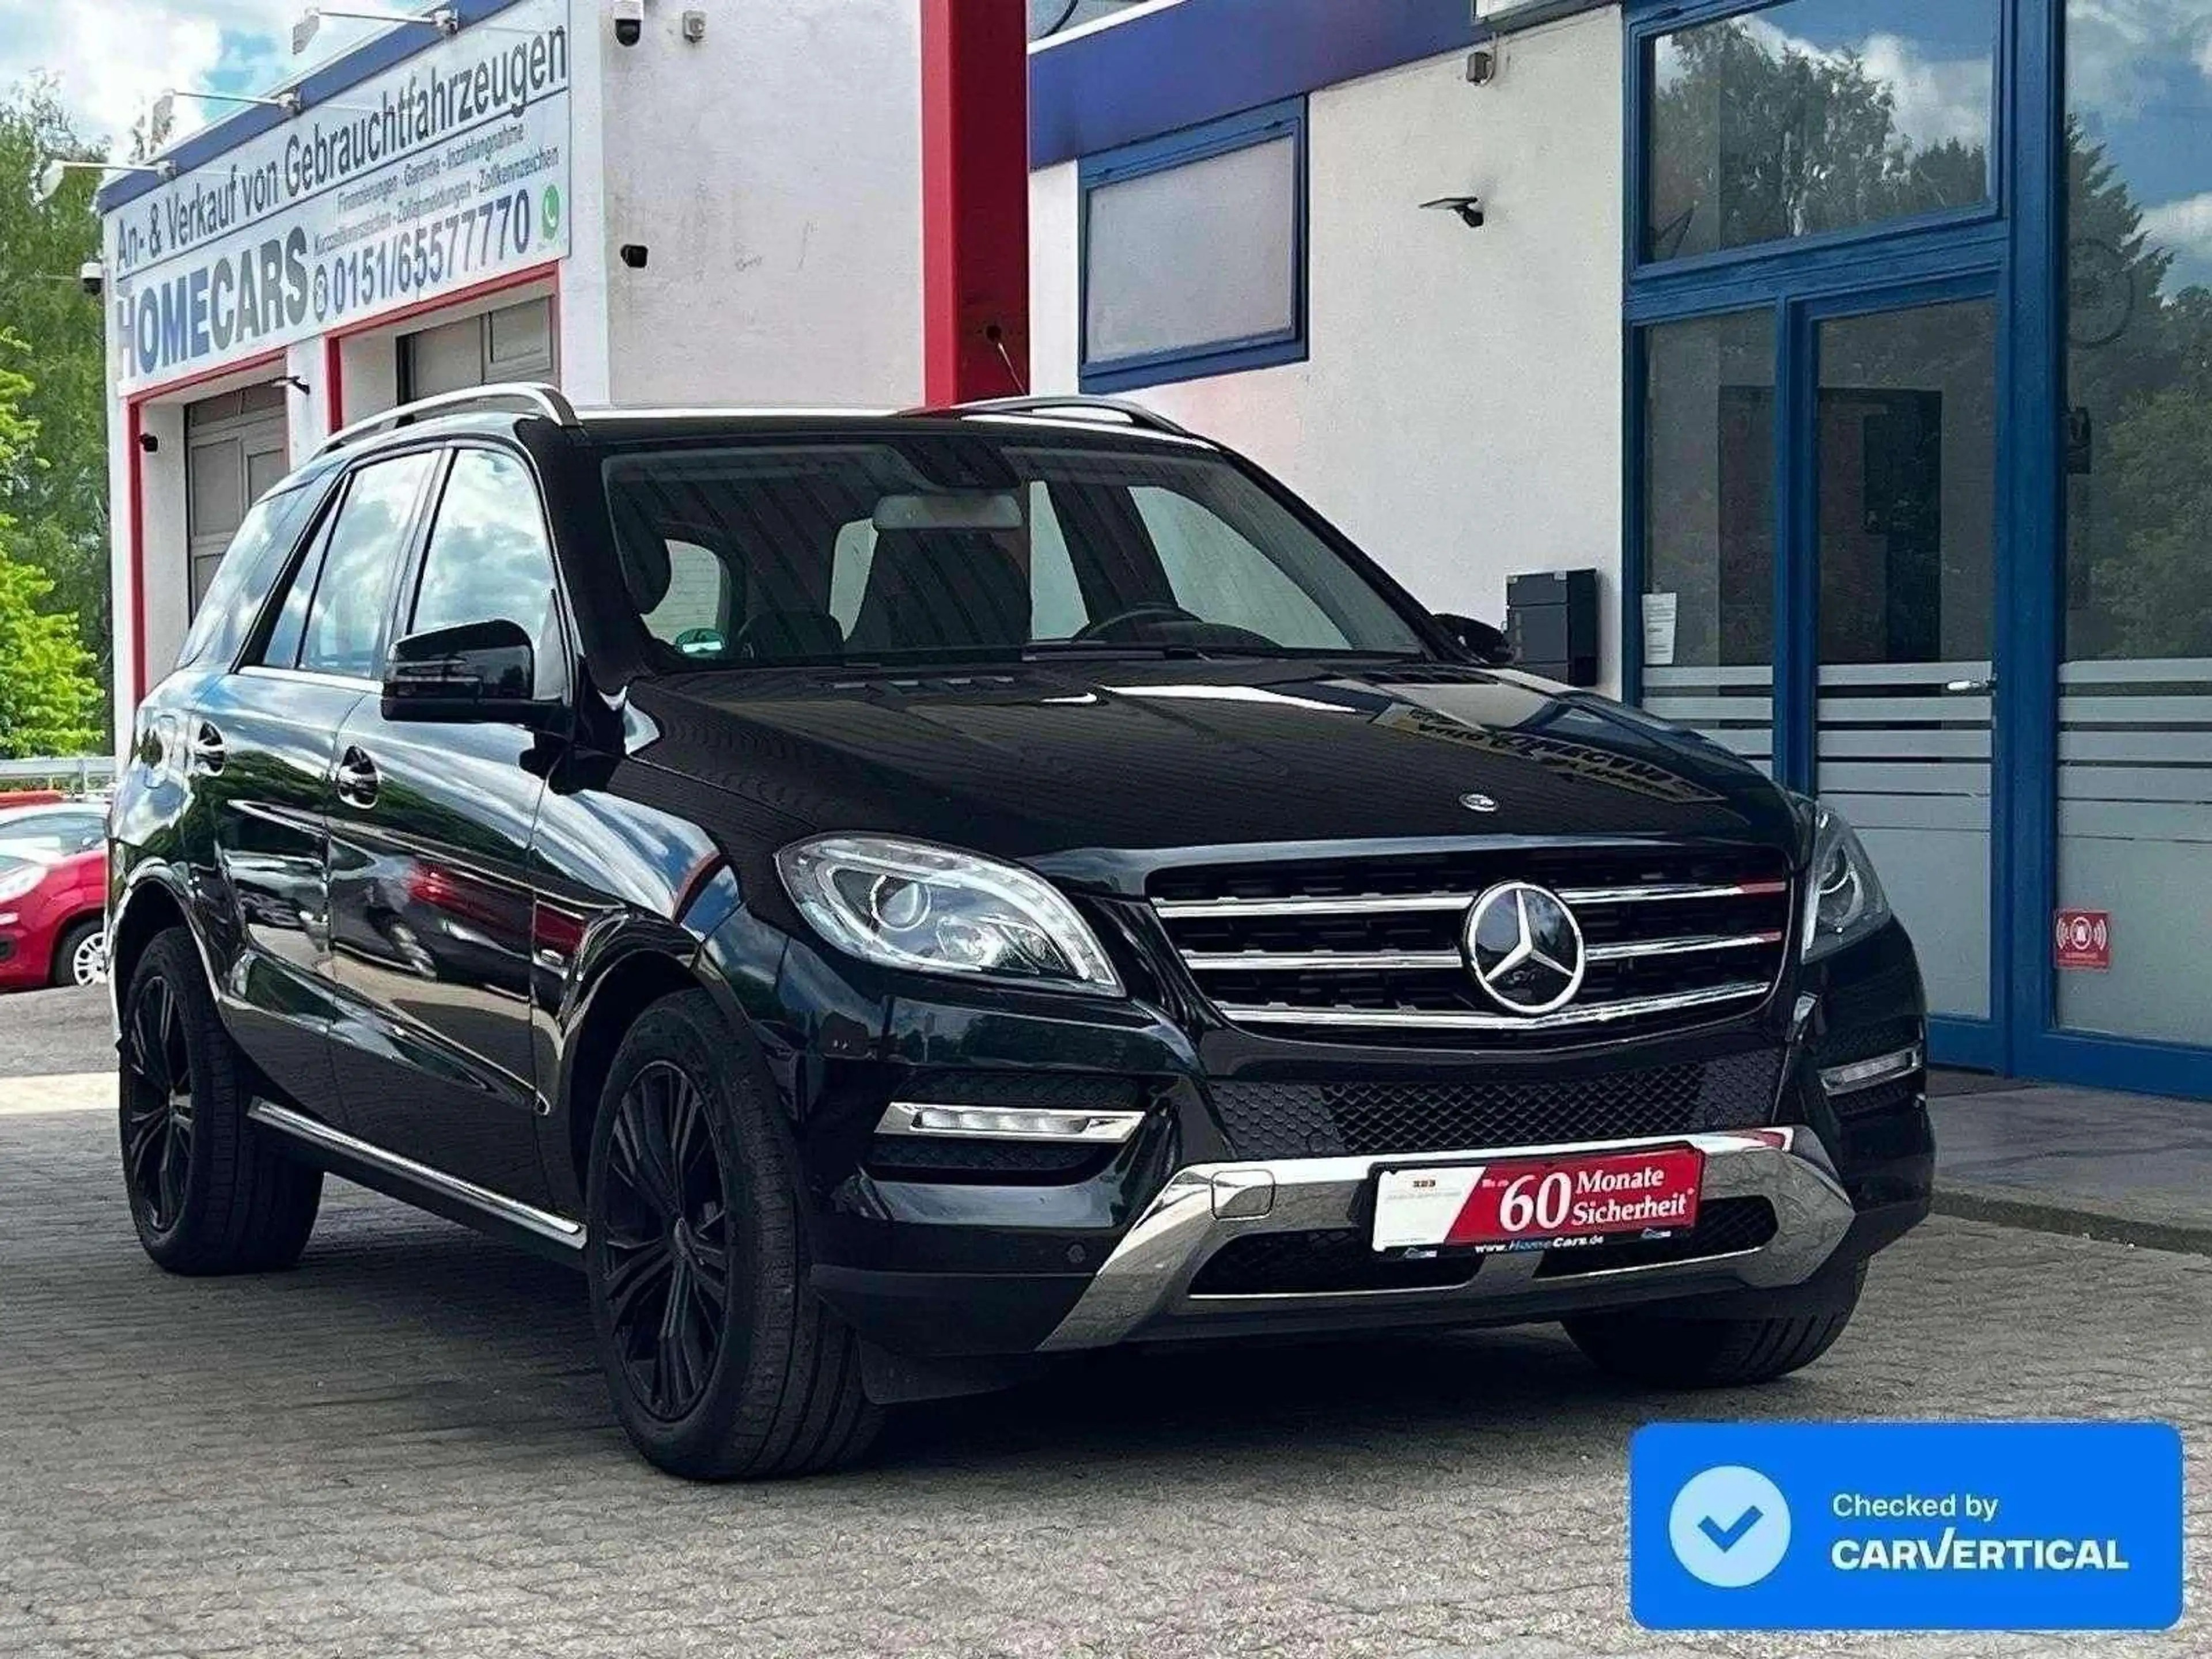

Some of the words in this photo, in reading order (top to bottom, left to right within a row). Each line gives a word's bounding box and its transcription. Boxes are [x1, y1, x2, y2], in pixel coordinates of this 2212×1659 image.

[117, 218, 144, 272] An-
[150, 202, 161, 258] &
[166, 164, 237, 249] Verkauf
[241, 161, 278, 217] von
[285, 25, 567, 197] Gebrauchtfahrzeugen
[117, 226, 308, 382] HOMECARS
[334, 188, 530, 314] 0151/65577770
[1499, 1172, 1571, 1232] 60
[1574, 1166, 1665, 1195] Monate
